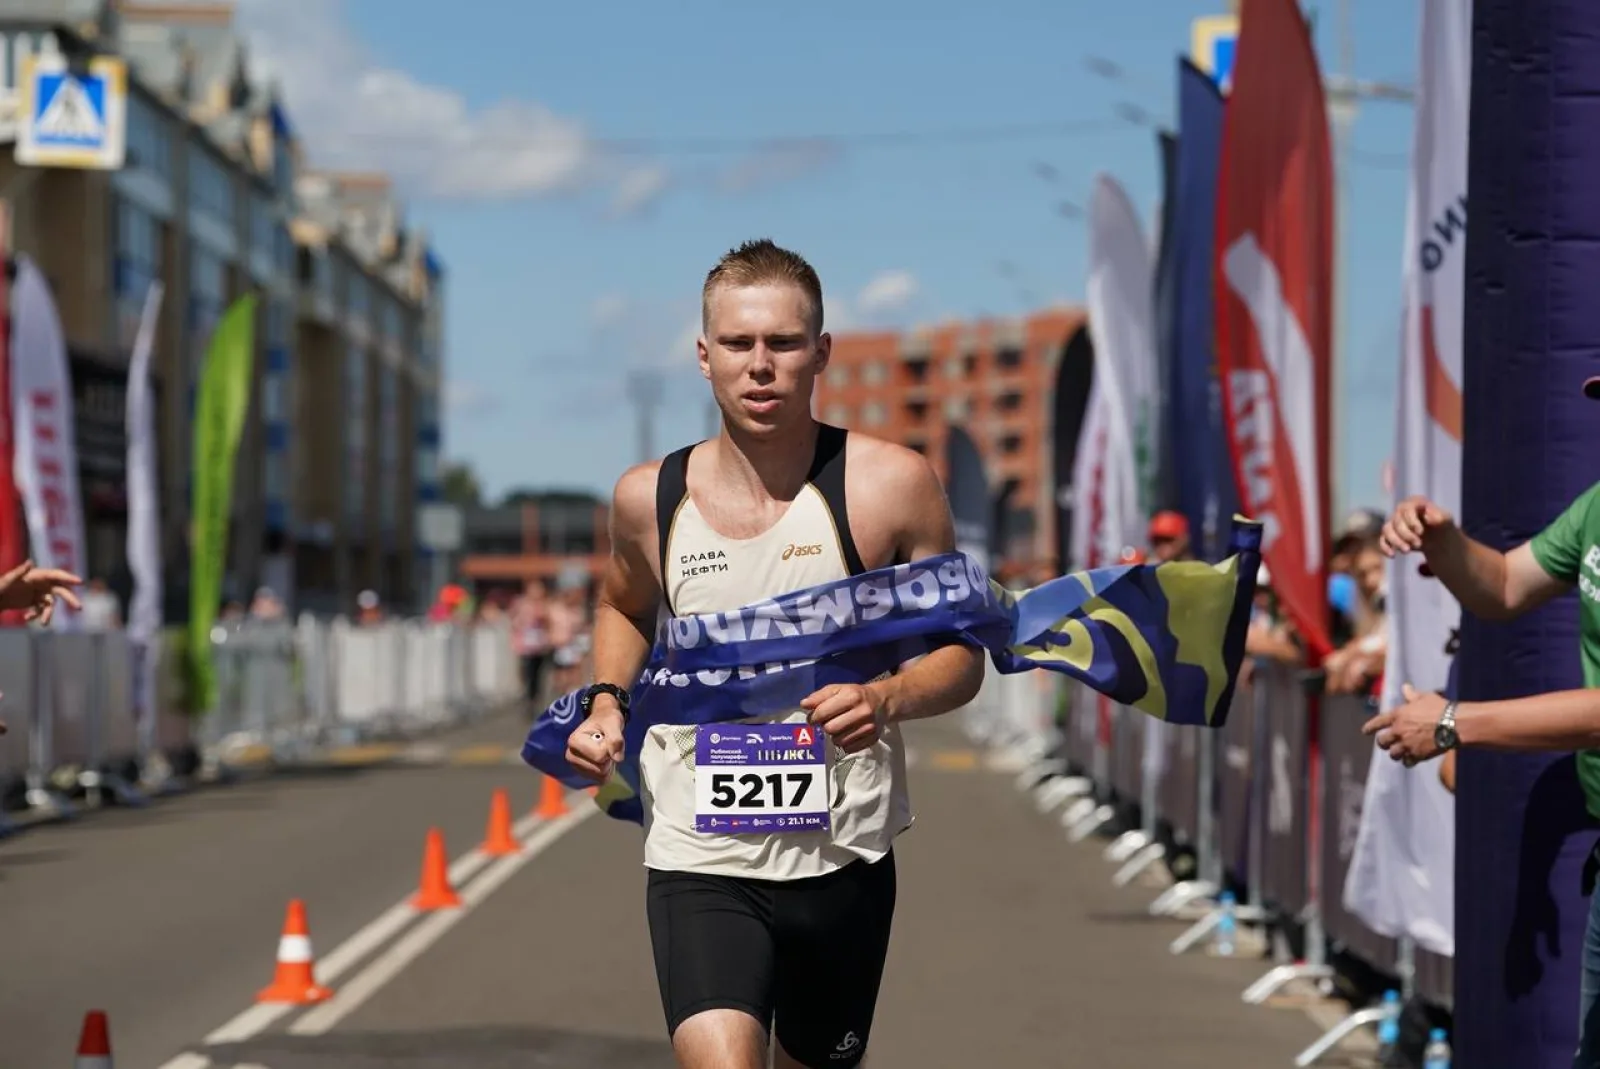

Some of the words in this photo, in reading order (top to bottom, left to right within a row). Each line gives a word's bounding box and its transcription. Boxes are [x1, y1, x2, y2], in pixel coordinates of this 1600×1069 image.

[680, 550, 726, 565] СЛАВА
[682, 563, 728, 578] НЕФТИ
[710, 773, 813, 808] 5217
[788, 817, 804, 825] 21.1
